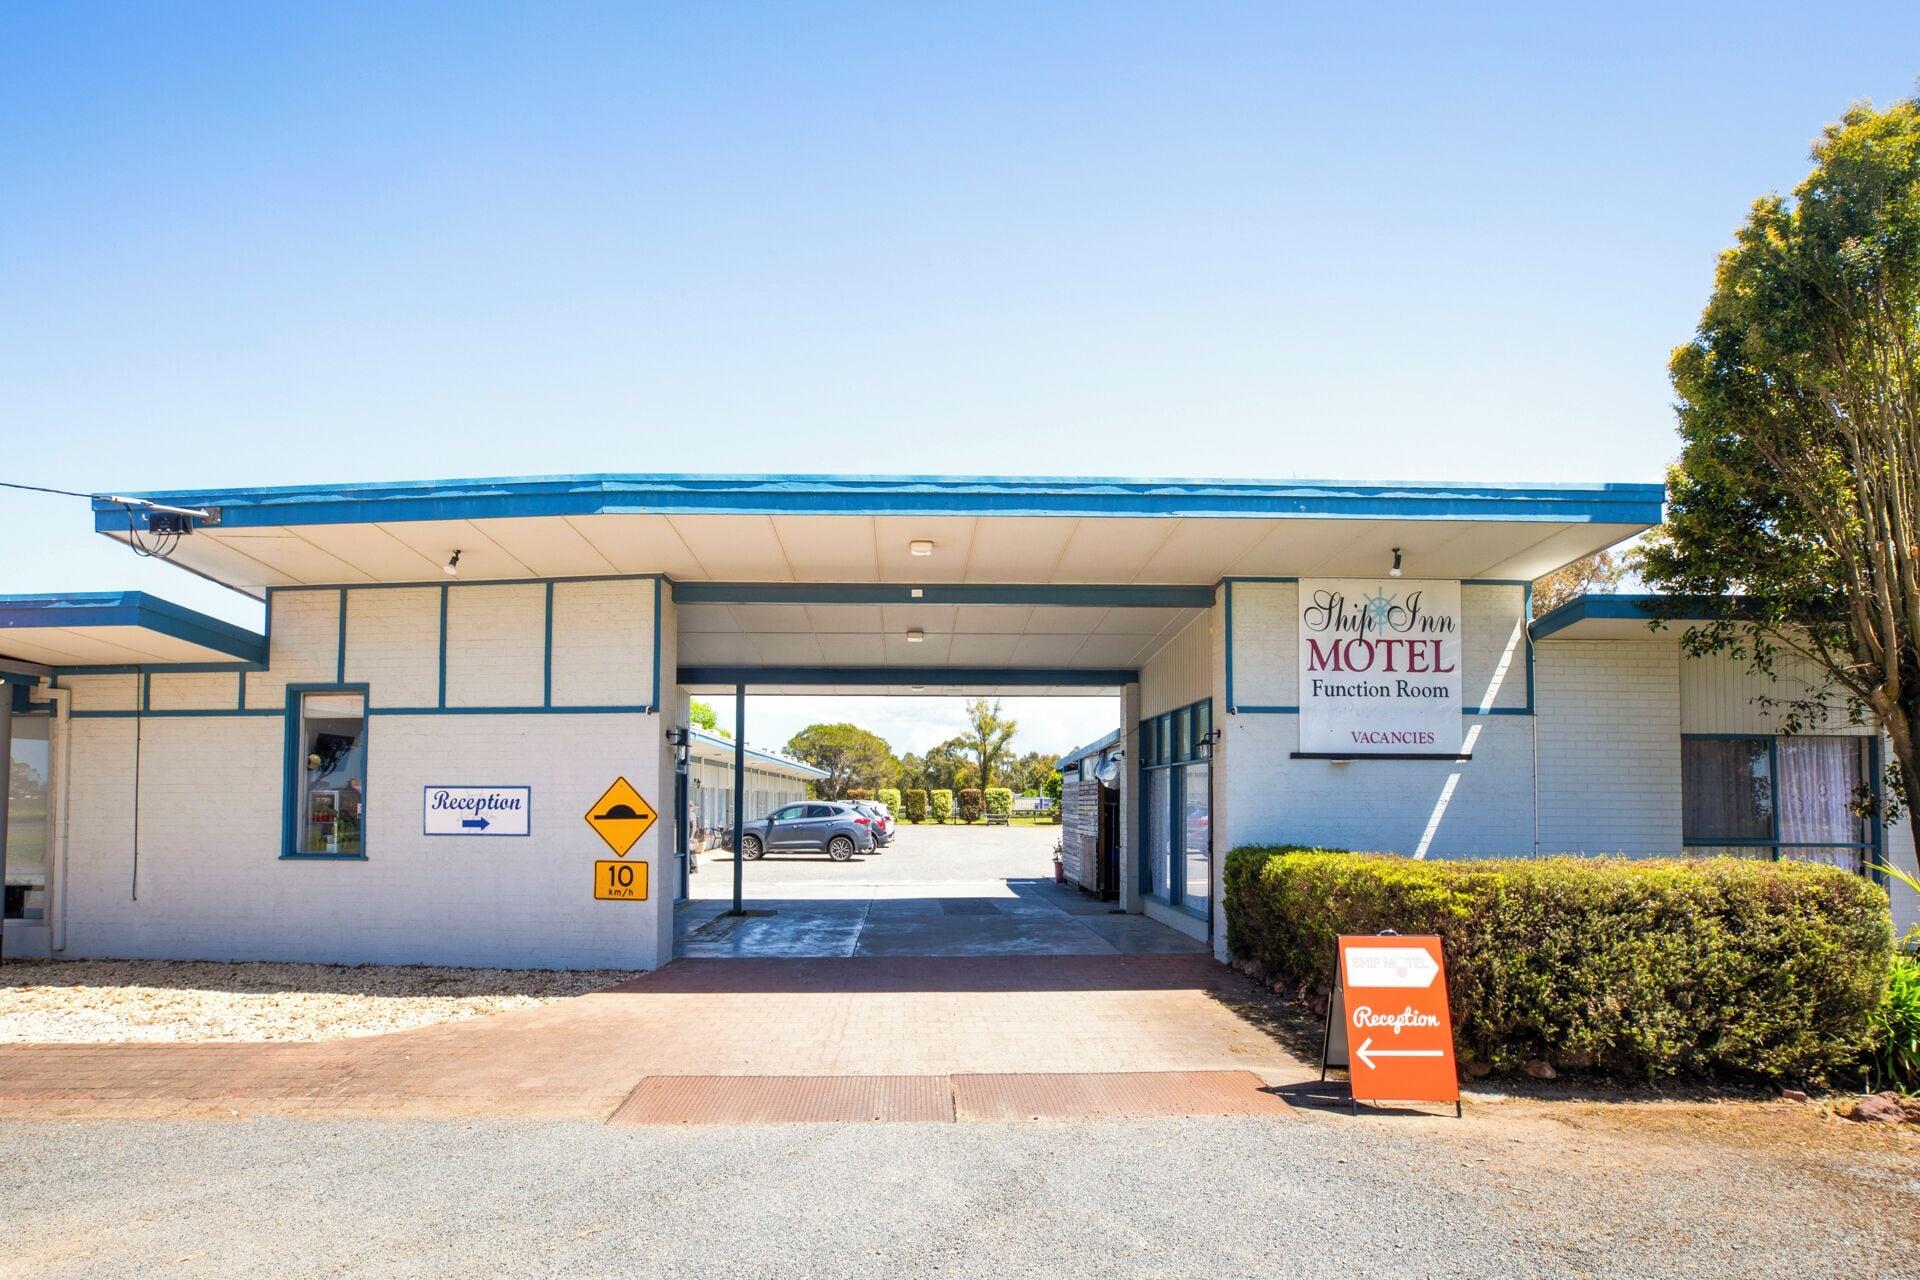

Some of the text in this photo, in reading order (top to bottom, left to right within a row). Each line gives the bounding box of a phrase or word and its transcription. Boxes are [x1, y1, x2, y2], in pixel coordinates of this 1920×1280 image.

[1304, 590, 1455, 647] Ship Inn
[1306, 638, 1455, 673] MOTEL
[1312, 679, 1449, 698] Function Room
[1351, 732, 1435, 744] VACANCIES
[431, 790, 522, 816] Reception
[608, 865, 634, 887] 10
[608, 888, 634, 897] km/h
[1353, 1006, 1440, 1035] Reception
